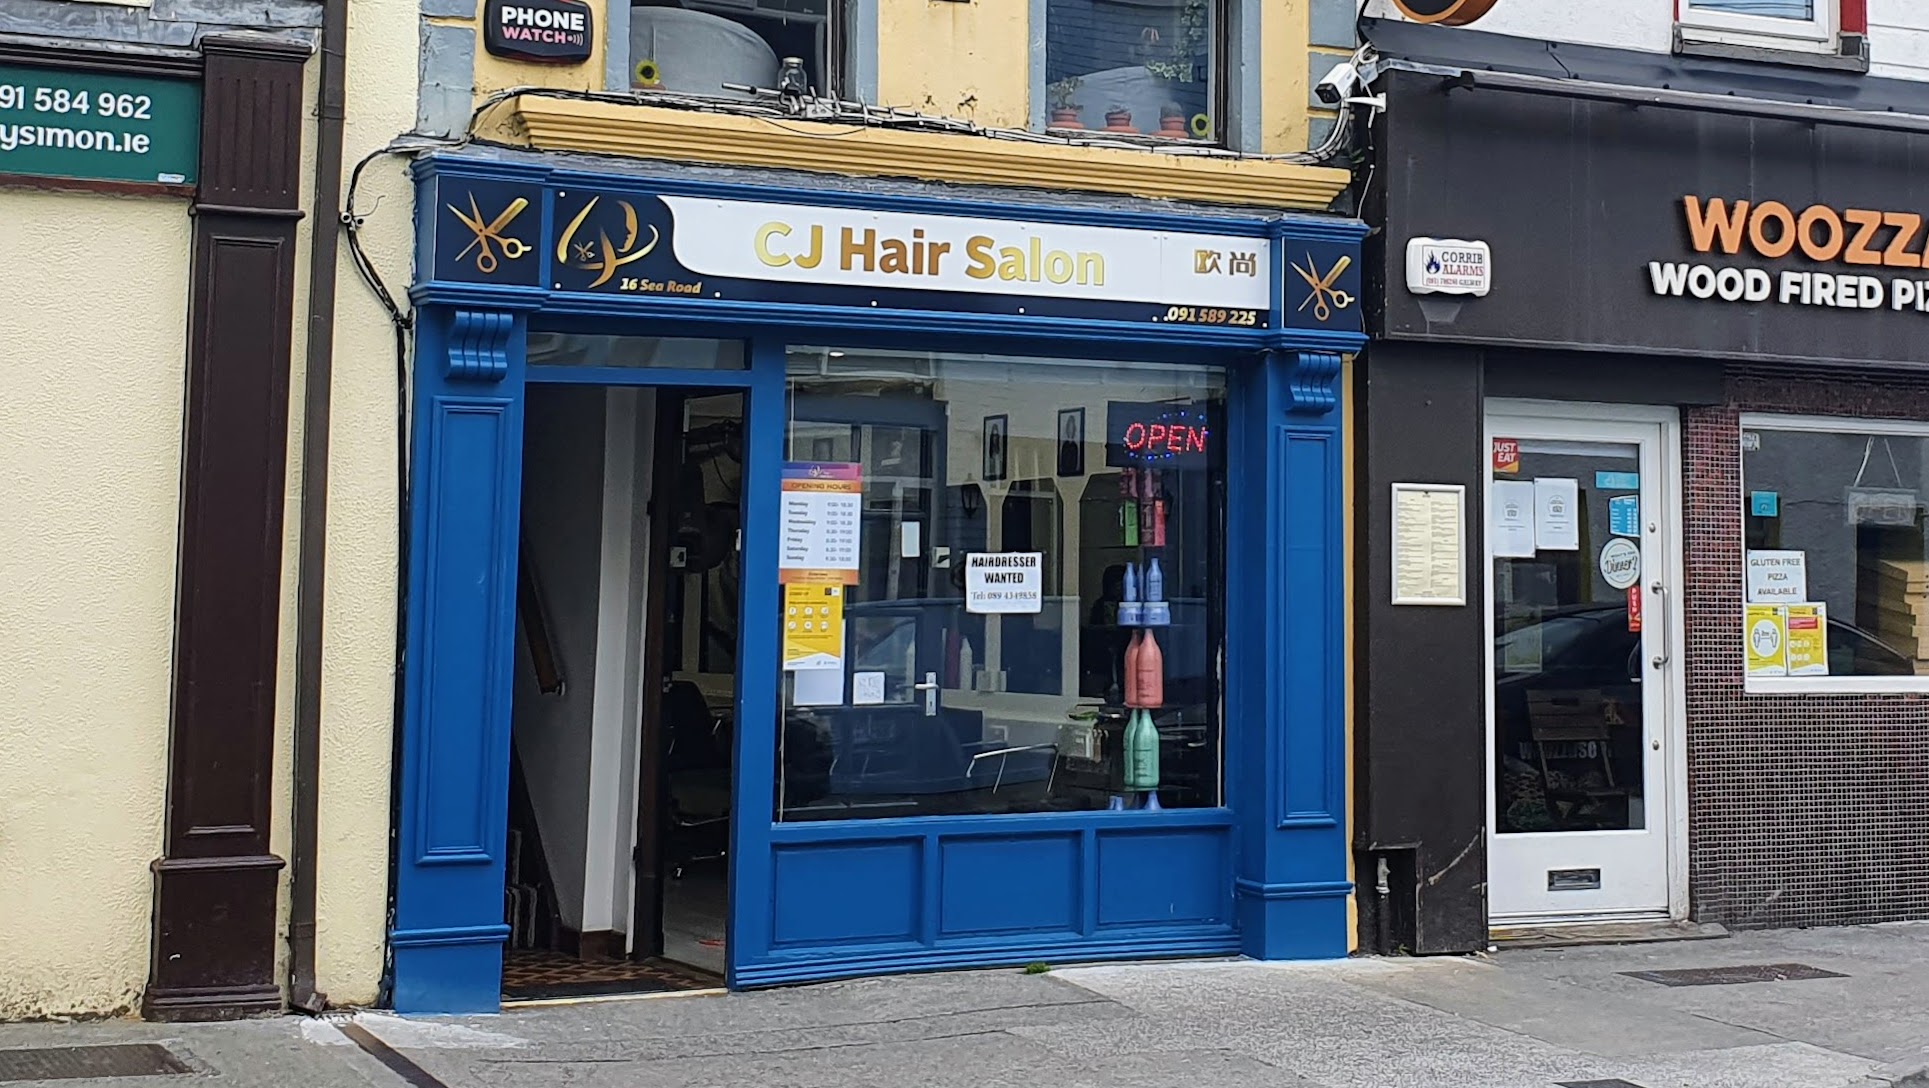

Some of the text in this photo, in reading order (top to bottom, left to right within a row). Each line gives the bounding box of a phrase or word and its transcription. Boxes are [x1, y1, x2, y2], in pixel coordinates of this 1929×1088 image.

[501, 6, 585, 31] PHONE
[502, 26, 567, 44] WATCH
[34, 87, 90, 115] 584
[98, 92, 152, 120] 962
[1684, 195, 1929, 268] WOOZZ
[754, 220, 1105, 287] CJ Hair Salon
[1441, 252, 1483, 264] CORRIB
[1442, 264, 1484, 276] ALARMS
[620, 277, 702, 294] 16 Sea Road
[1649, 261, 1929, 312] WOOD FIRED PI
[1167, 307, 1256, 325] 091 589 225
[1126, 422, 1206, 453] OPEN
[1494, 441, 1516, 453] JUST
[1497, 452, 1516, 463] EAT
[971, 556, 1036, 568] HAIRDRESSER
[1750, 558, 1801, 567] GLUTEN FREE
[984, 572, 1024, 584] WANTED
[1767, 573, 1788, 581] PIZZA
[1757, 587, 1797, 596] AVAILABLE
